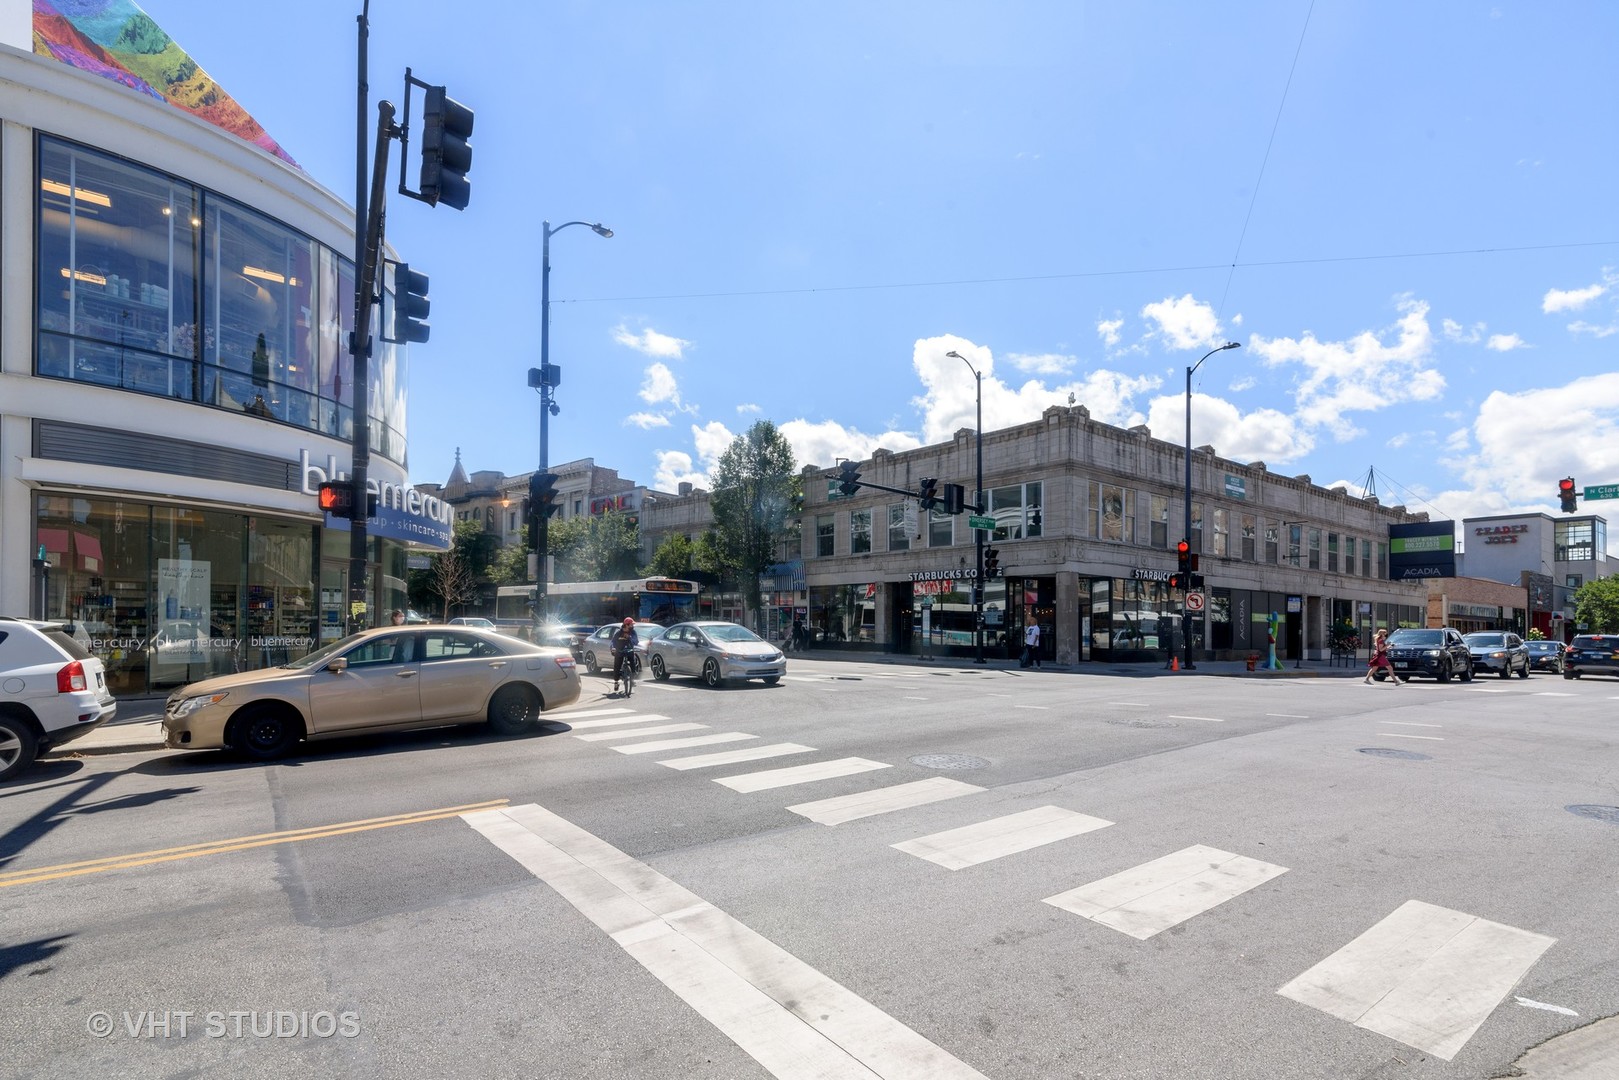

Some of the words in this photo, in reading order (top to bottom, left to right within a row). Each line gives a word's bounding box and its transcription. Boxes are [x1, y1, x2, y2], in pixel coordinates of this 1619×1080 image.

[300, 448, 455, 528] blemercury
[591, 494, 632, 515] GNC
[397, 520, 435, 538] skincare
[439, 532, 450, 544] spa
[1475, 524, 1528, 536] TRADER
[908, 569, 962, 581] STARBUCKS
[964, 567, 1003, 578] COE
[1403, 567, 1442, 577] ACADIA
[80, 637, 146, 651] mercury
[156, 634, 242, 650] bluemercury
[251, 635, 316, 649] bluemercury
